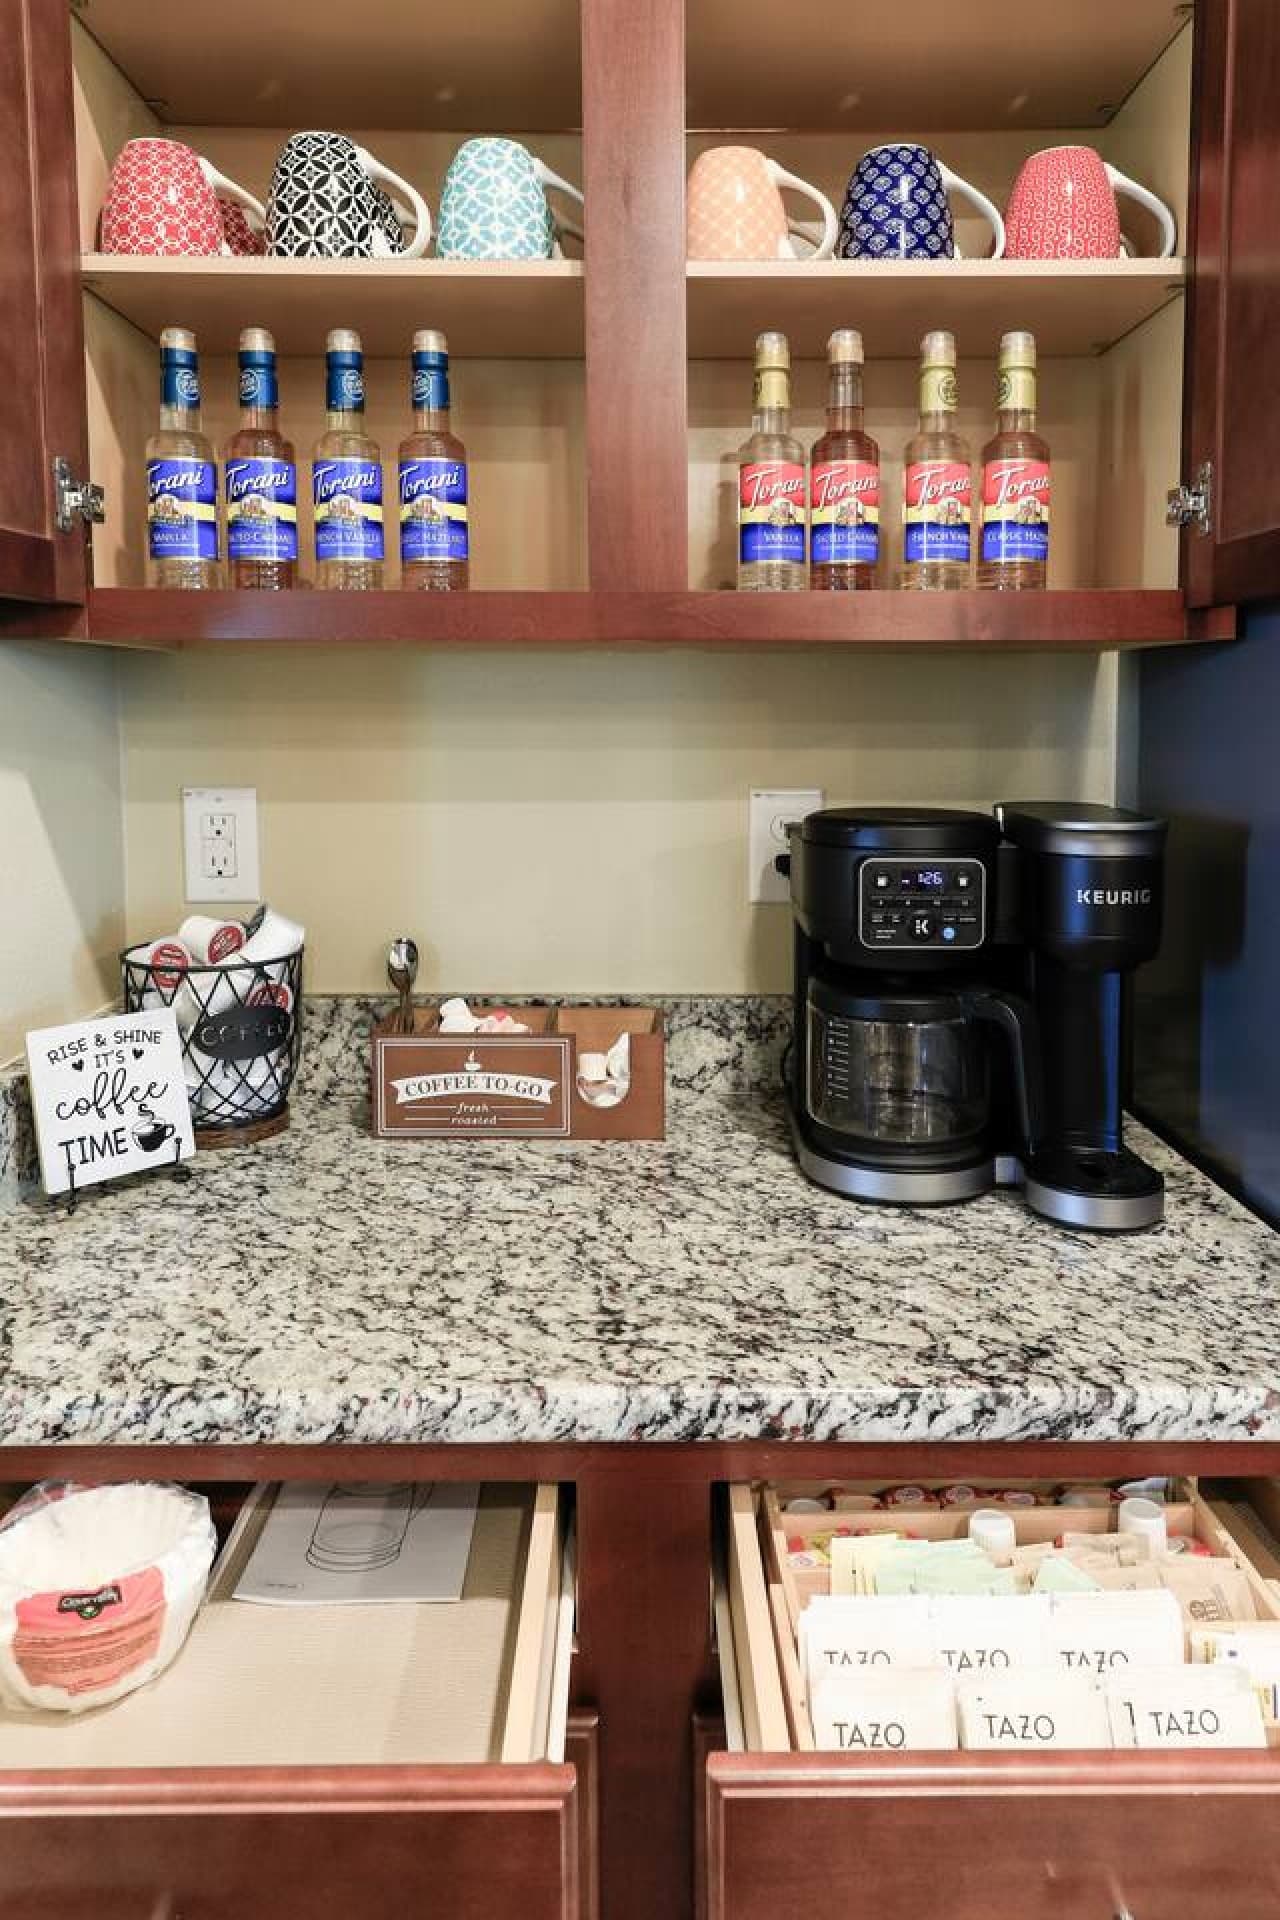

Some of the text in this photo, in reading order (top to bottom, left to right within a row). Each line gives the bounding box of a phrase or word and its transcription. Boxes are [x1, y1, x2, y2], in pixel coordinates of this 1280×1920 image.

[226, 463, 289, 502] Torani
[313, 464, 377, 502] Torani
[399, 464, 460, 500] Torani
[1077, 889, 1151, 905] KEURIG
[47, 1029, 162, 1064] RISE & SHINE
[55, 1067, 169, 1121] coffee
[405, 1075, 543, 1097] COFFEE TO-GO
[449, 1115, 497, 1125] roasted
[455, 1101, 489, 1115] fresh
[58, 1127, 128, 1165] TIME
[832, 1722, 906, 1749] TAZO
[982, 1714, 1055, 1741] TAZO
[1148, 1709, 1220, 1737] TAZO
